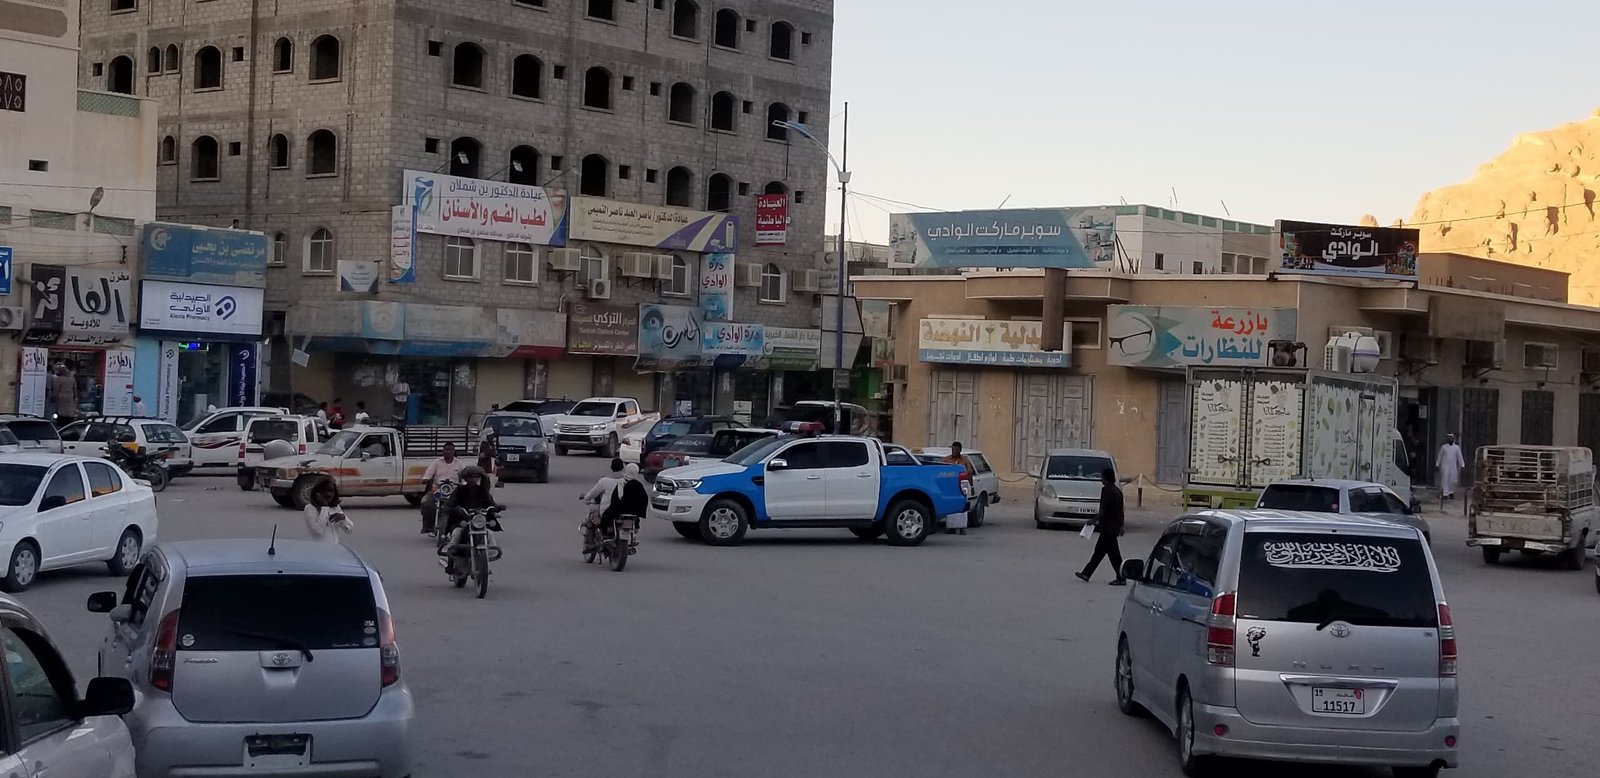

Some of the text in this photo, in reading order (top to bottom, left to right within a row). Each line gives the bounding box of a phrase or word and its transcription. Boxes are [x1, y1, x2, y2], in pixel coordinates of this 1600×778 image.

[450, 180, 543, 200] عيادة الدكتور بن شملان
[442, 196, 547, 229] لطب الفم والأسنان
[758, 197, 785, 210] العيادة
[927, 221, 974, 241] الوادي
[1330, 227, 1371, 240] سوبر ماركت
[1322, 240, 1379, 262] الوادي
[109, 271, 130, 283] مخزن
[701, 274, 728, 288] الوادي
[593, 311, 622, 328] التركي
[1211, 310, 1269, 336] بازرعة
[717, 325, 743, 343] الوادي
[1181, 335, 1264, 364] للنظارات
[1323, 700, 1356, 712] 11517
